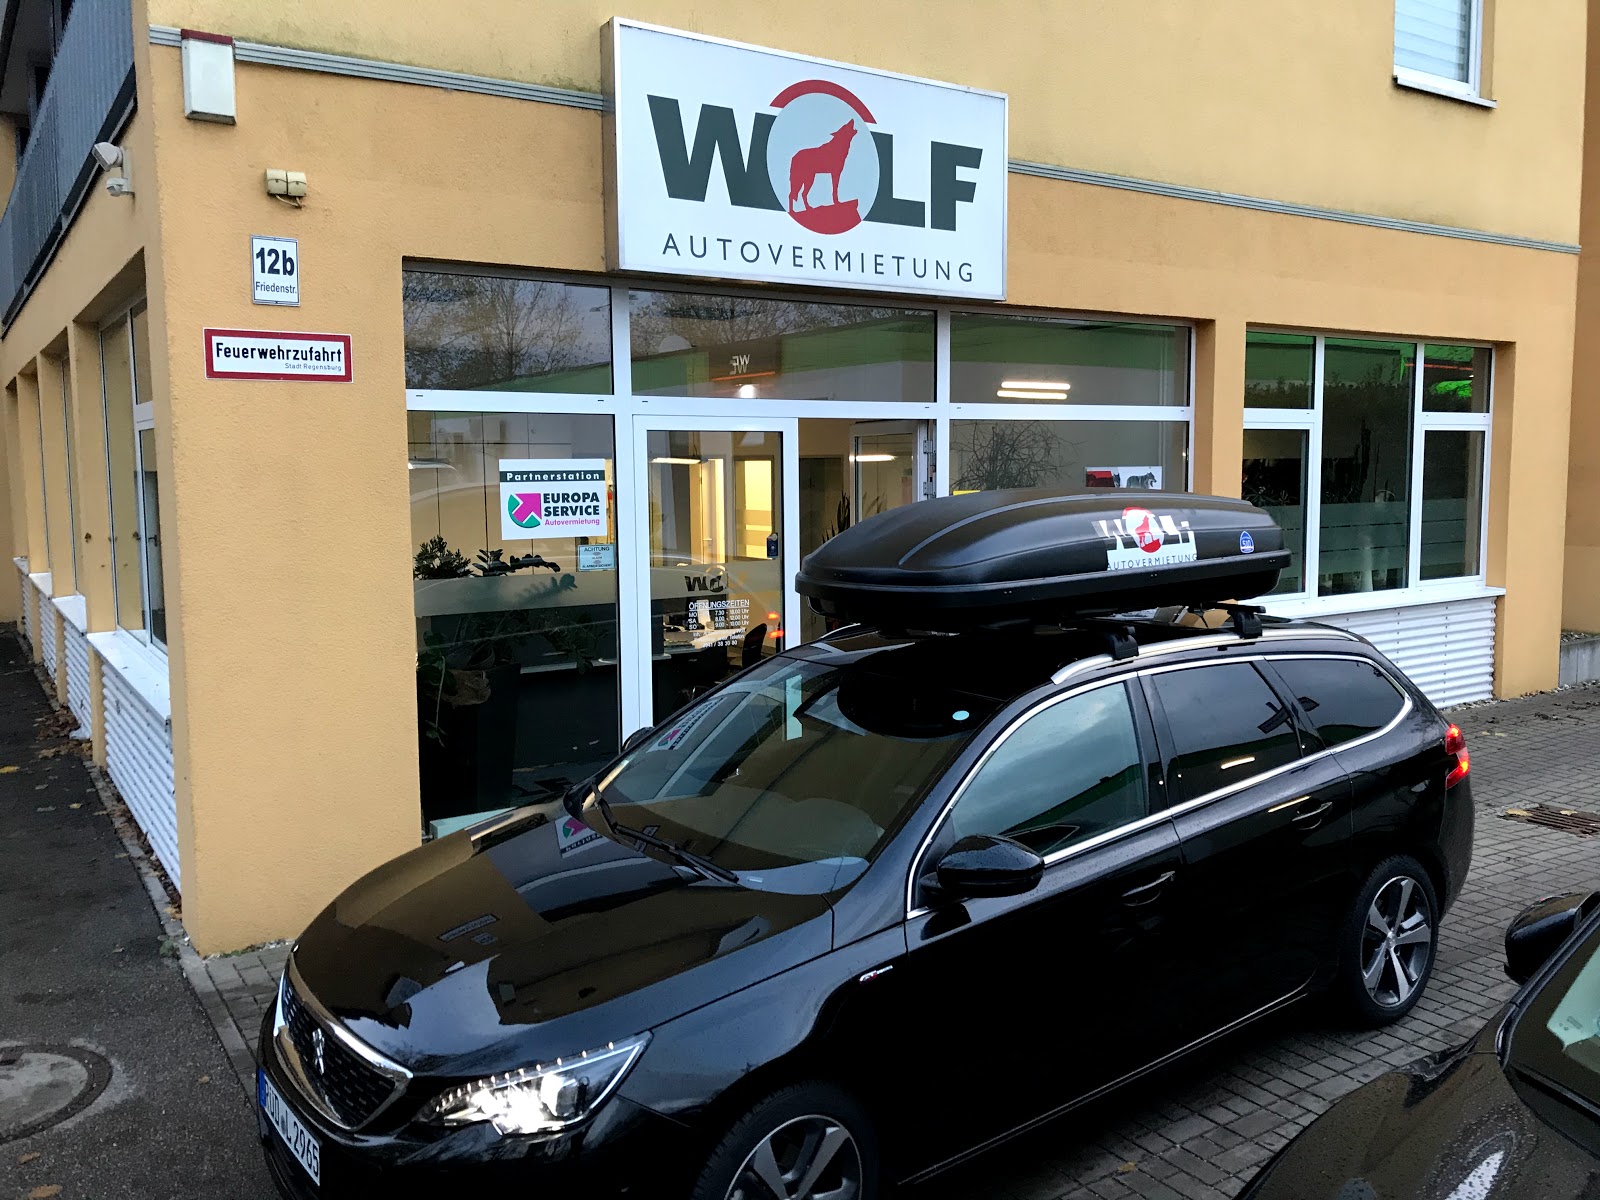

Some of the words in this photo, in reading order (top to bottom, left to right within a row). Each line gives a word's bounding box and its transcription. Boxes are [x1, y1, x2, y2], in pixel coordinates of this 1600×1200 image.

[647, 82, 983, 233] WOLF
[255, 247, 295, 276] 12b
[662, 232, 974, 284] AUTOVERMIETUNG
[255, 281, 297, 294] Friedenstr.
[216, 342, 342, 362] Feuerwehrzufahrt
[284, 362, 302, 370] Stadt
[304, 363, 342, 372] Regensburg
[506, 472, 600, 481] Partnerstation
[543, 492, 600, 504] EUROPA
[543, 505, 600, 517] SERVICE
[544, 518, 600, 526] Autovermietung
[1108, 553, 1197, 570] AUTOVERMIETUNG
[689, 599, 749, 610] ÖFFNUNGSZEITEN
[294, 1120, 319, 1178] 2965
